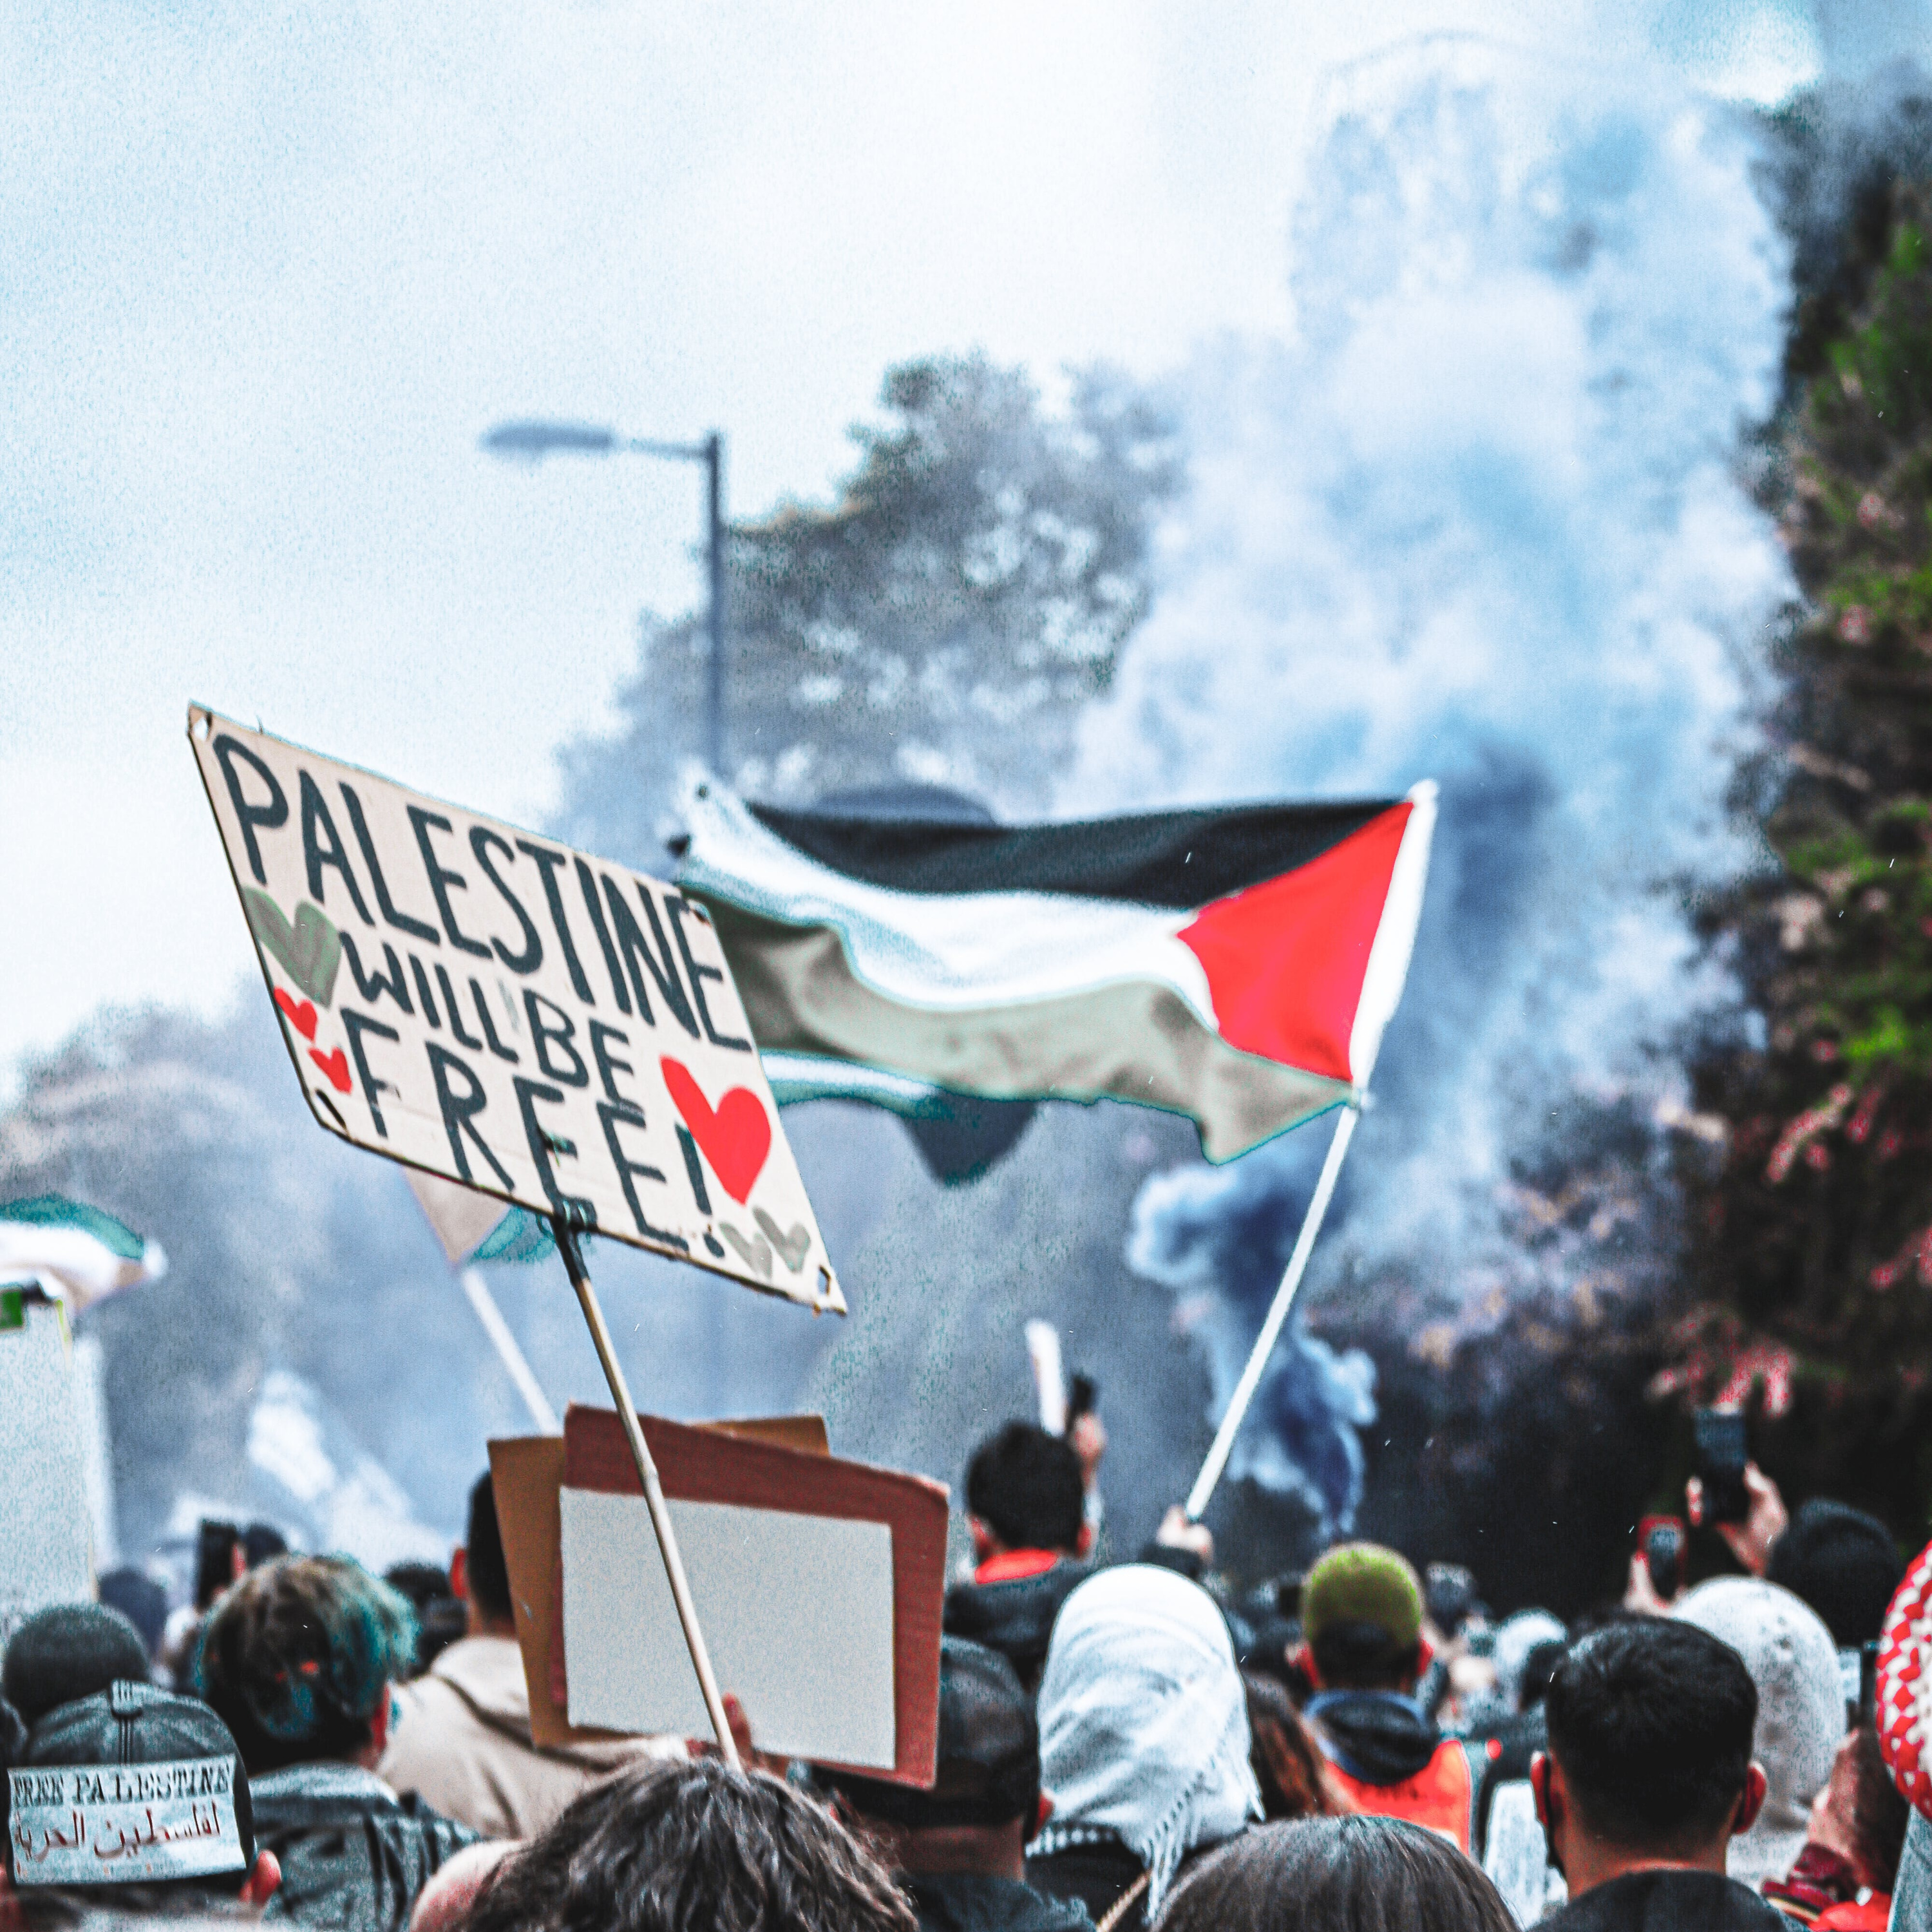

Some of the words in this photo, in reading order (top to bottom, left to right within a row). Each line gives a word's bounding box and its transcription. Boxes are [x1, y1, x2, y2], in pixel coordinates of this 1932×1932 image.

[213, 734, 752, 1052] PALESTINE
[339, 931, 519, 1063] WILL
[522, 988, 643, 1114] BE
[340, 1007, 725, 1257] FREE!
[13, 1774, 64, 1806] FREE
[73, 1763, 230, 1803] PALESTINE
